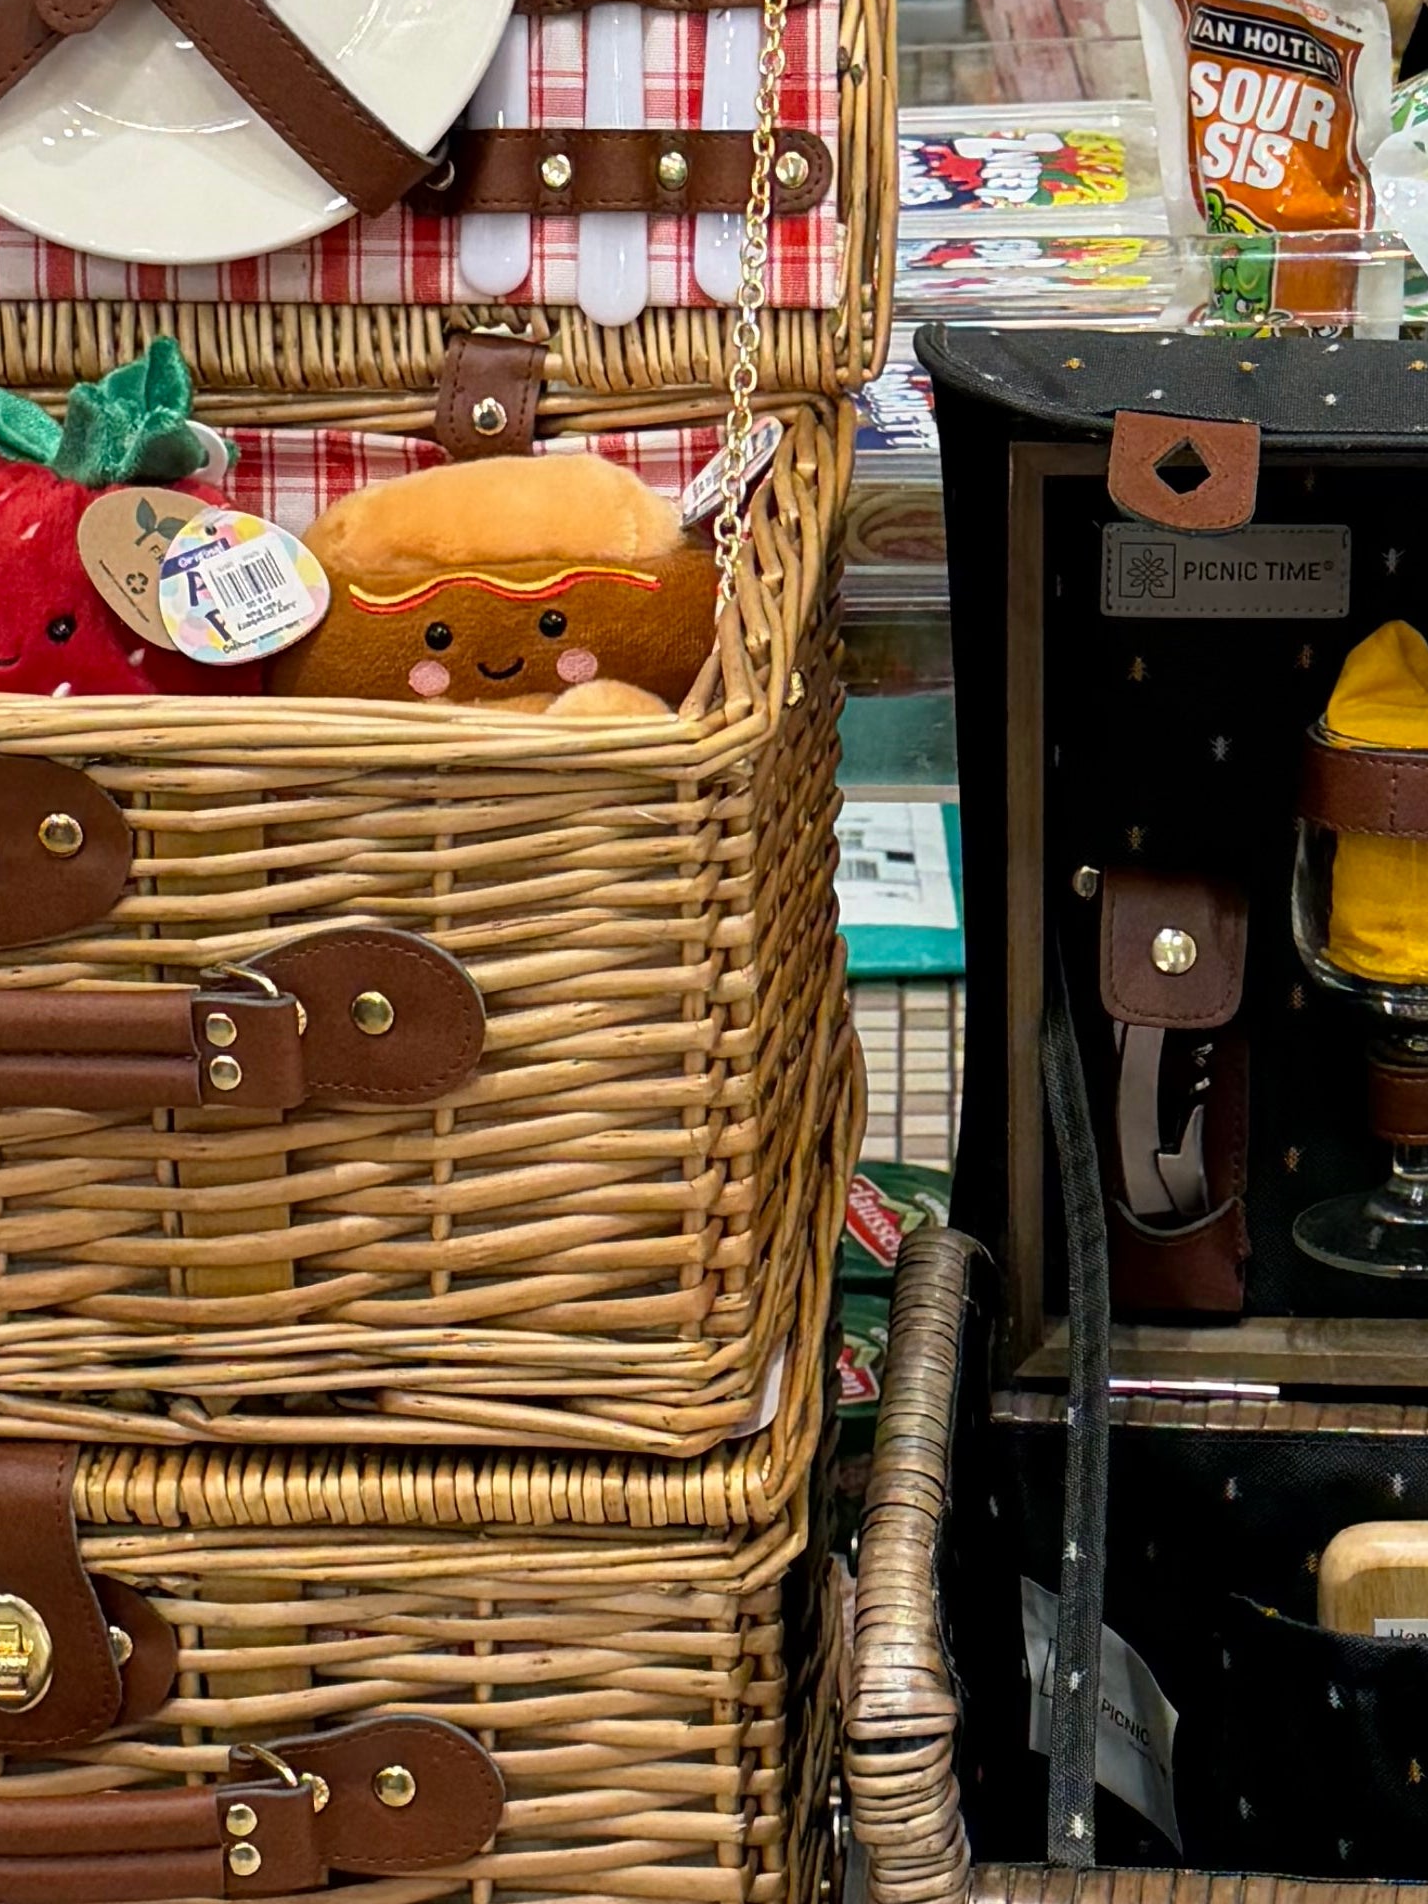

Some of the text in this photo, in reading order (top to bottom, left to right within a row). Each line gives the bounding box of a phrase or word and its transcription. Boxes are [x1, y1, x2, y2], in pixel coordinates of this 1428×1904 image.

[1190, 61, 1335, 149] SOUR
[1202, 121, 1293, 189] SIS
[1183, 561, 1258, 581] PICNIC
[1101, 1698, 1151, 1745] PICNIC
